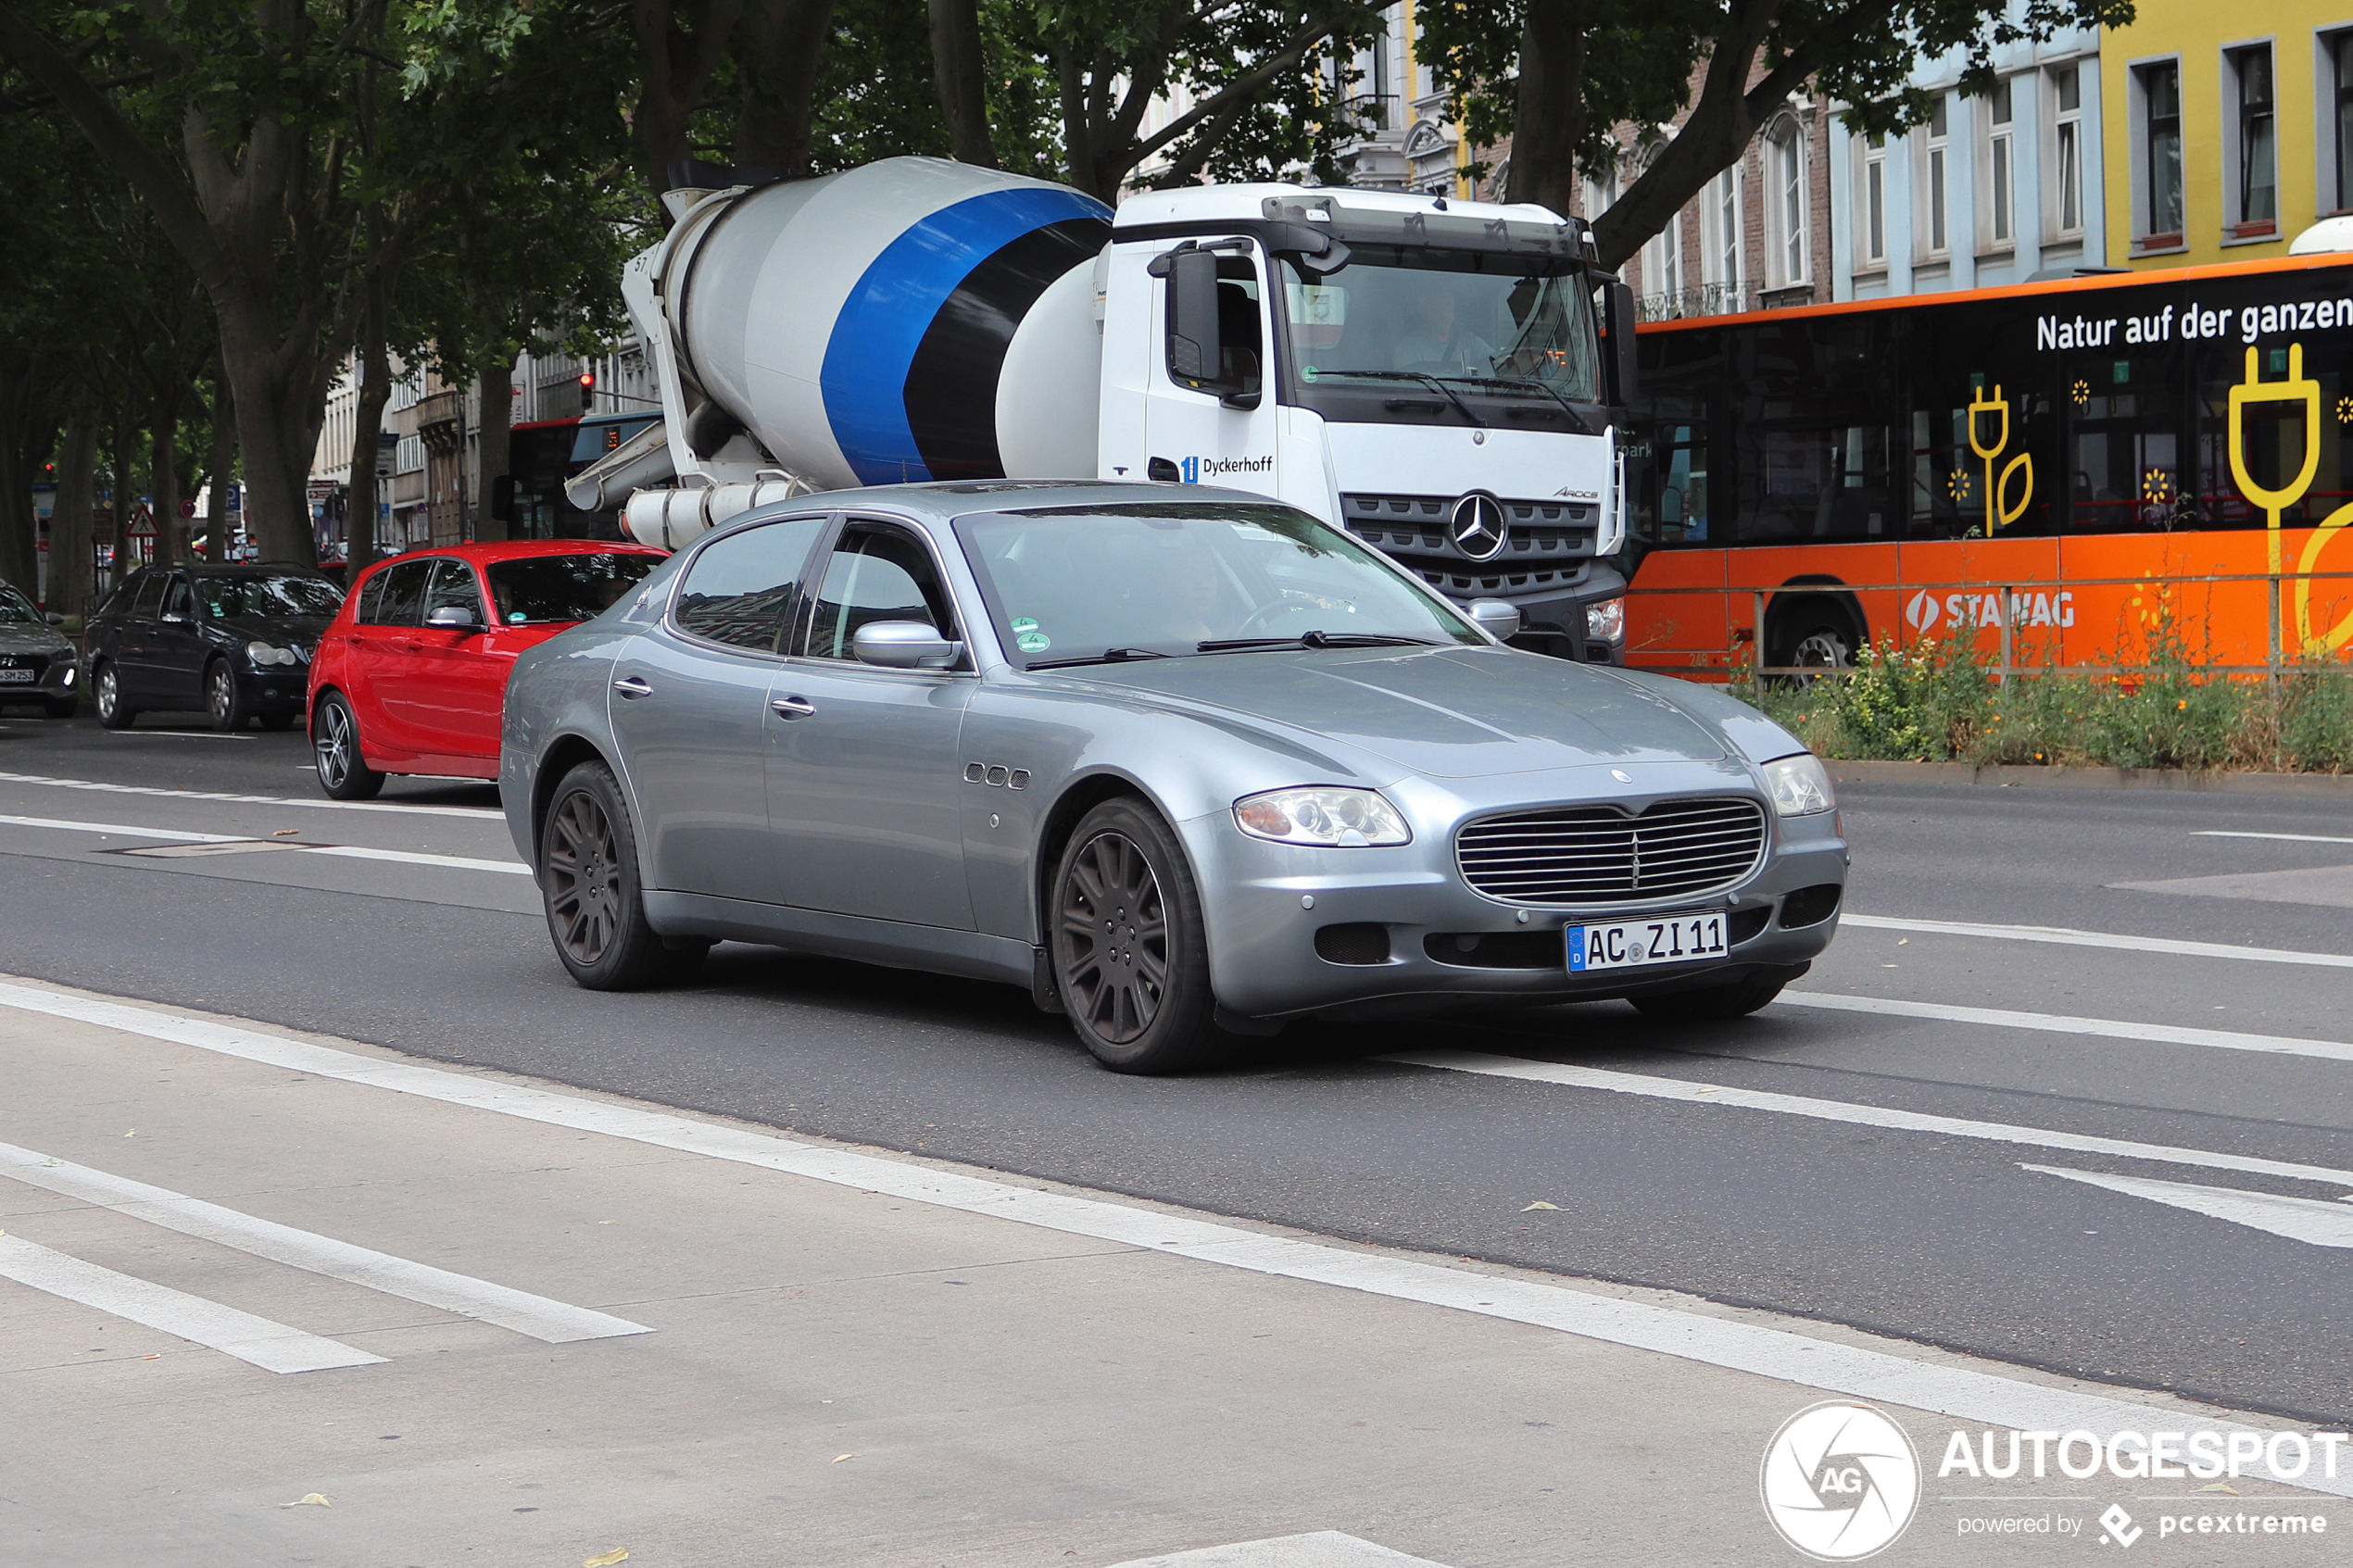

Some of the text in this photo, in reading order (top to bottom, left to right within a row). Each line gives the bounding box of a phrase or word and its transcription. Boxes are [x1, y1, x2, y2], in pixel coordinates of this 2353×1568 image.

[634, 257, 648, 272] 57
[2036, 297, 2353, 351] Natur auf der ganzen
[1203, 455, 1273, 477] Dyckerhoff
[1945, 592, 2075, 629] STAWAG
[17, 671, 33, 680] 253
[1573, 918, 1724, 964] D AC ZI 11
